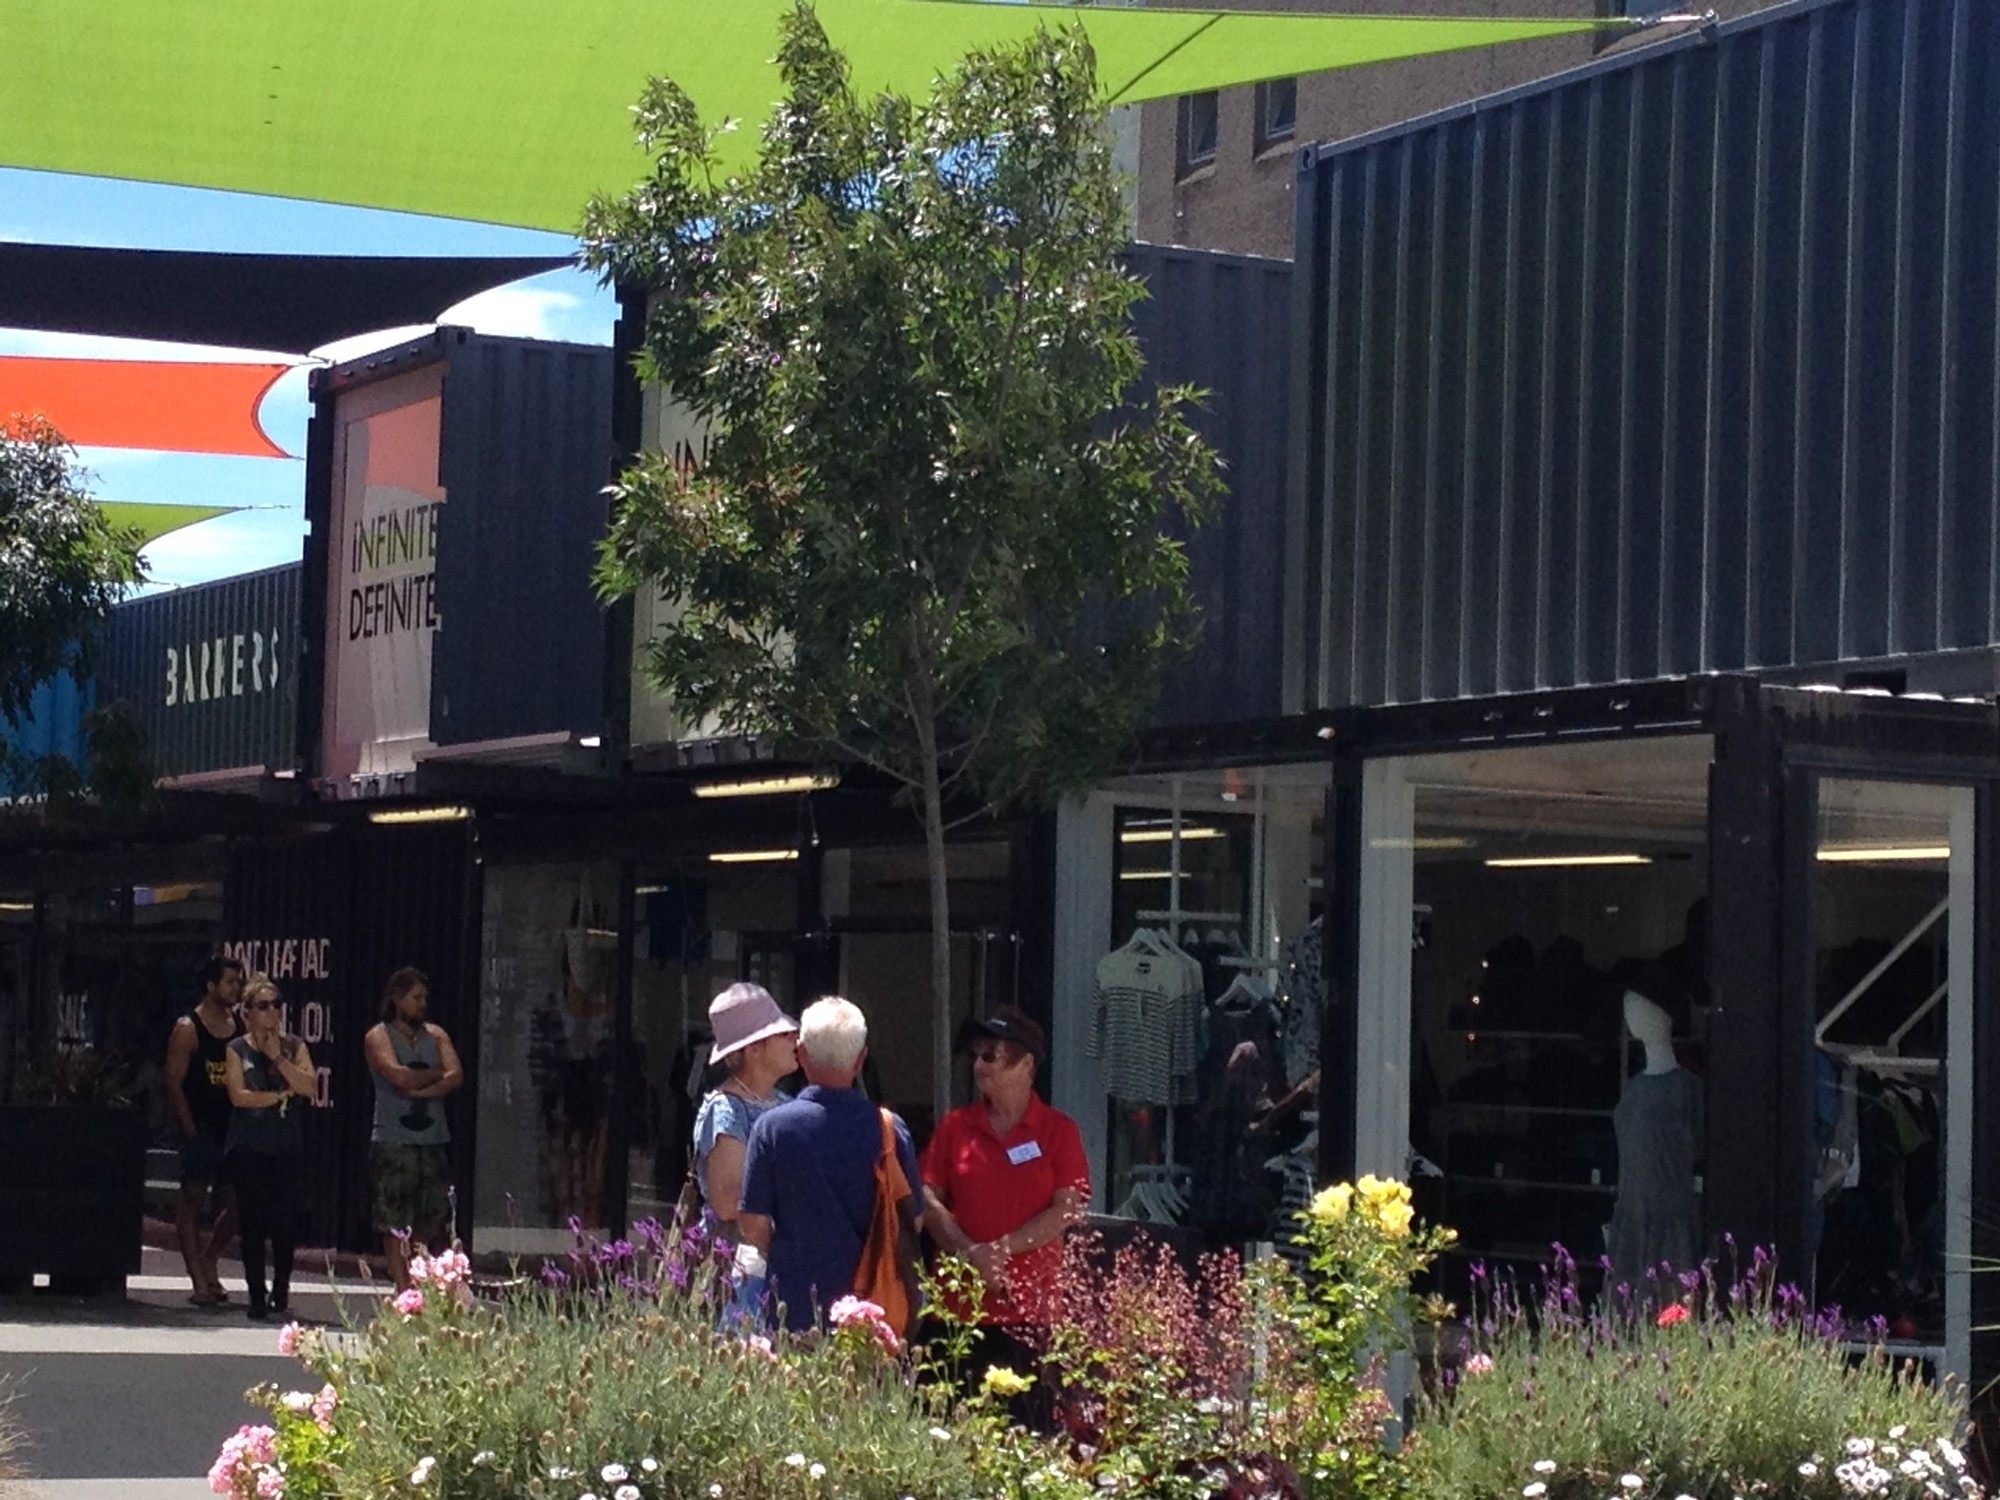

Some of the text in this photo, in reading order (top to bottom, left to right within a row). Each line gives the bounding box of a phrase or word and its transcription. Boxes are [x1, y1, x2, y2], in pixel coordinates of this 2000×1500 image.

[352, 503, 437, 573] INFINITE
[349, 574, 438, 641] DEFINITE
[165, 626, 279, 707] BARKERS
